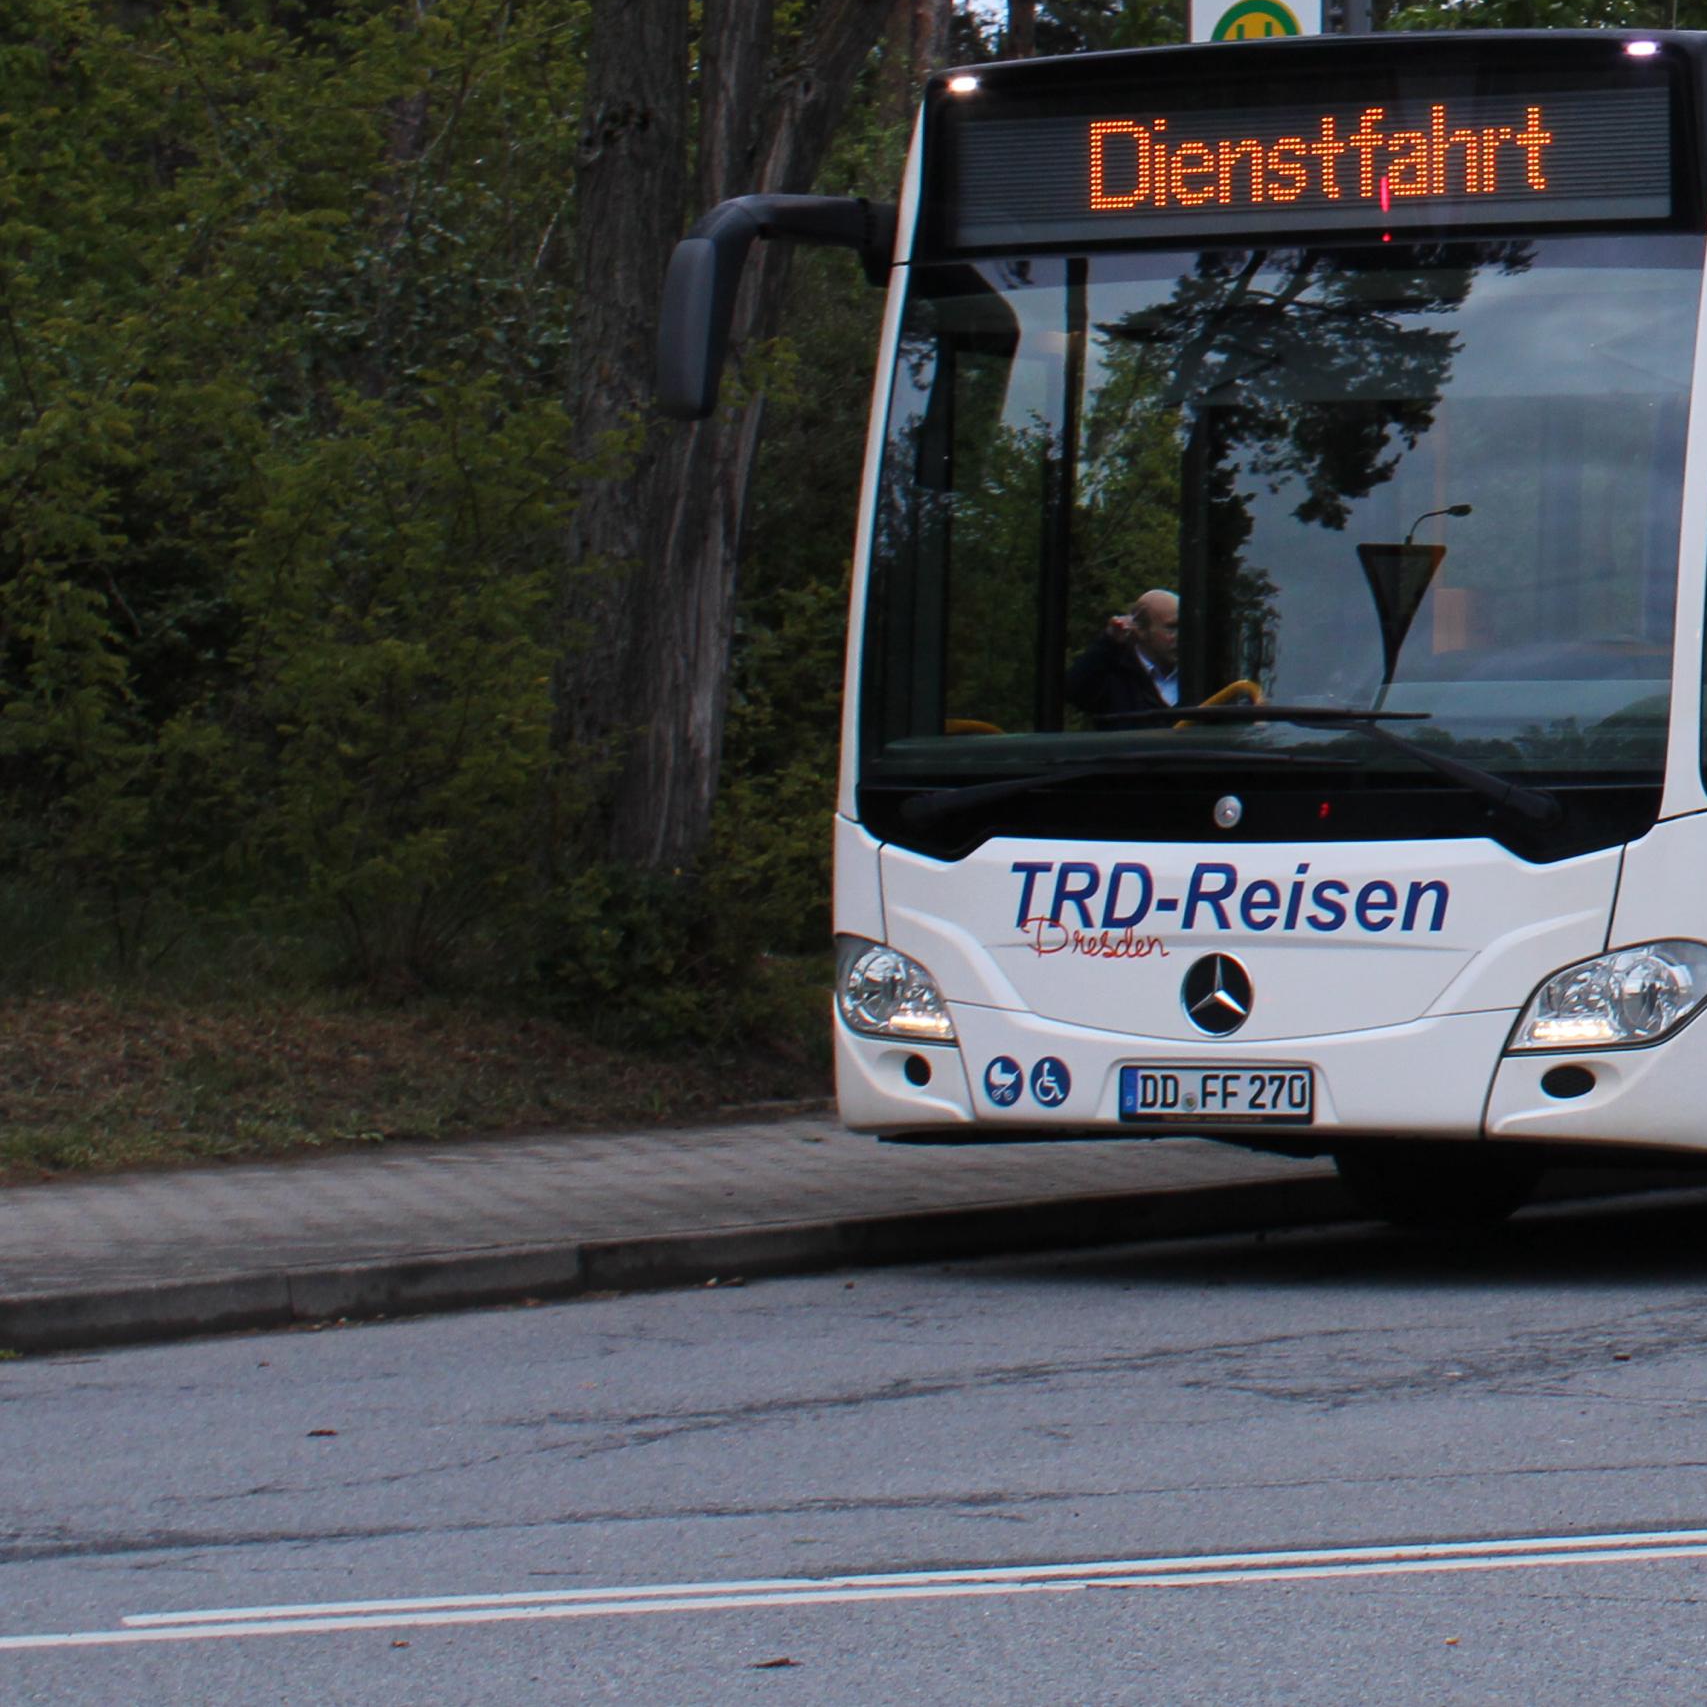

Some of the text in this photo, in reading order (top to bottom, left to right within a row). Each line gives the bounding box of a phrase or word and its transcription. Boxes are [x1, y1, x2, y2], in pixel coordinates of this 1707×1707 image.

[1090, 104, 1552, 210] Dienstfahrt
[1010, 861, 1450, 933] TRD-Reisen
[1019, 915, 1170, 959] Dresden
[1140, 1074, 1307, 1110] DD FF 270
